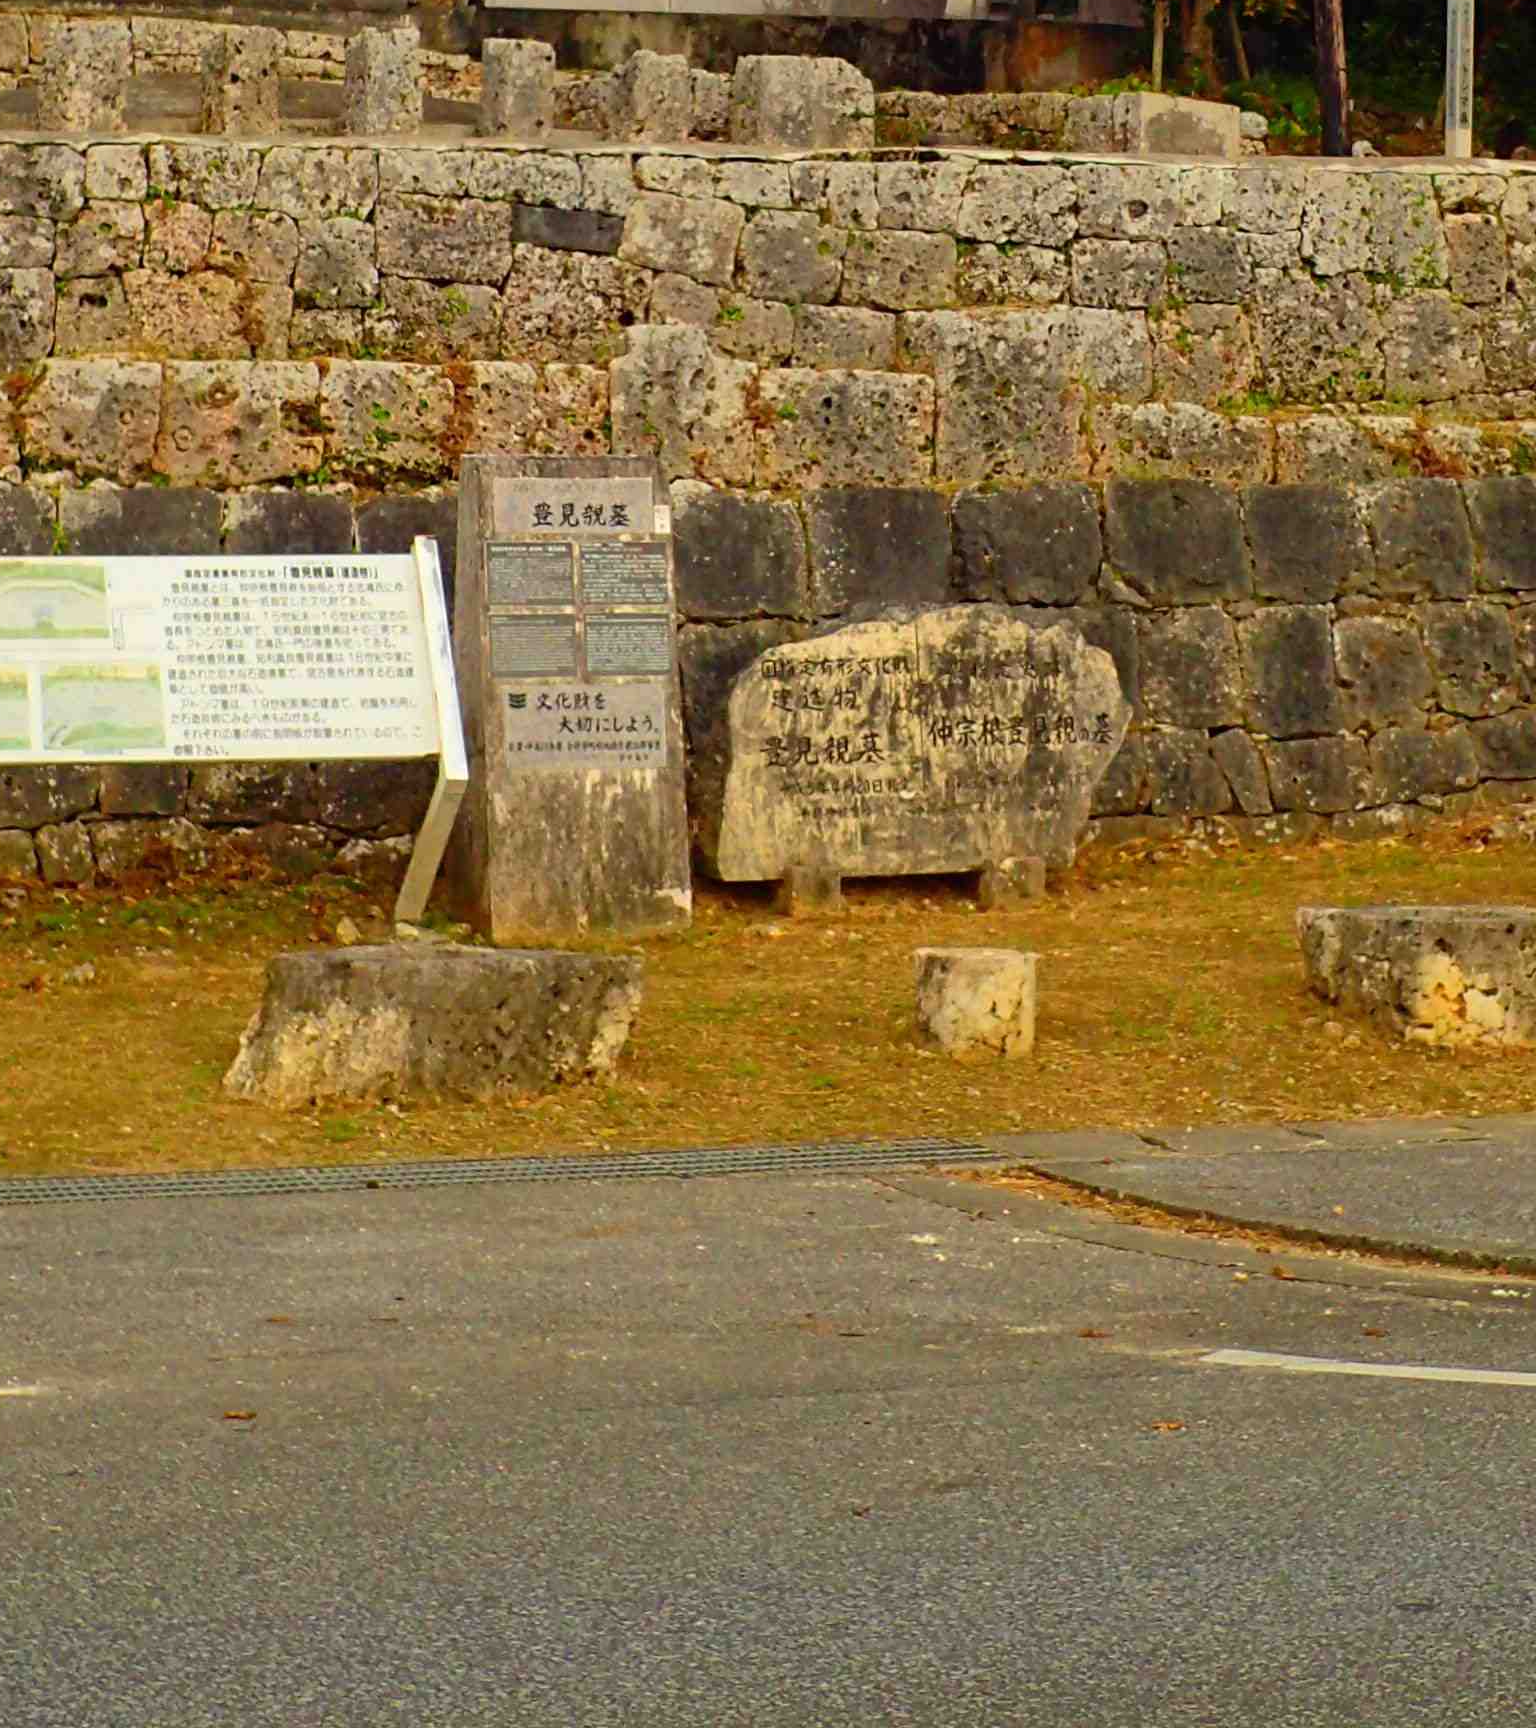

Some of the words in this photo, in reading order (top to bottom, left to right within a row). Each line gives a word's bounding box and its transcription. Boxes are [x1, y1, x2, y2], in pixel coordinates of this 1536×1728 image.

[532, 503, 631, 528] 豊見親墓
[536, 691, 607, 710] 文化財を
[771, 687, 859, 713] 建造物
[558, 715, 660, 734] 大切にしよう。
[927, 711, 1115, 747] 仲宗根豊見親の墓
[760, 732, 887, 767] 豊見親墓
